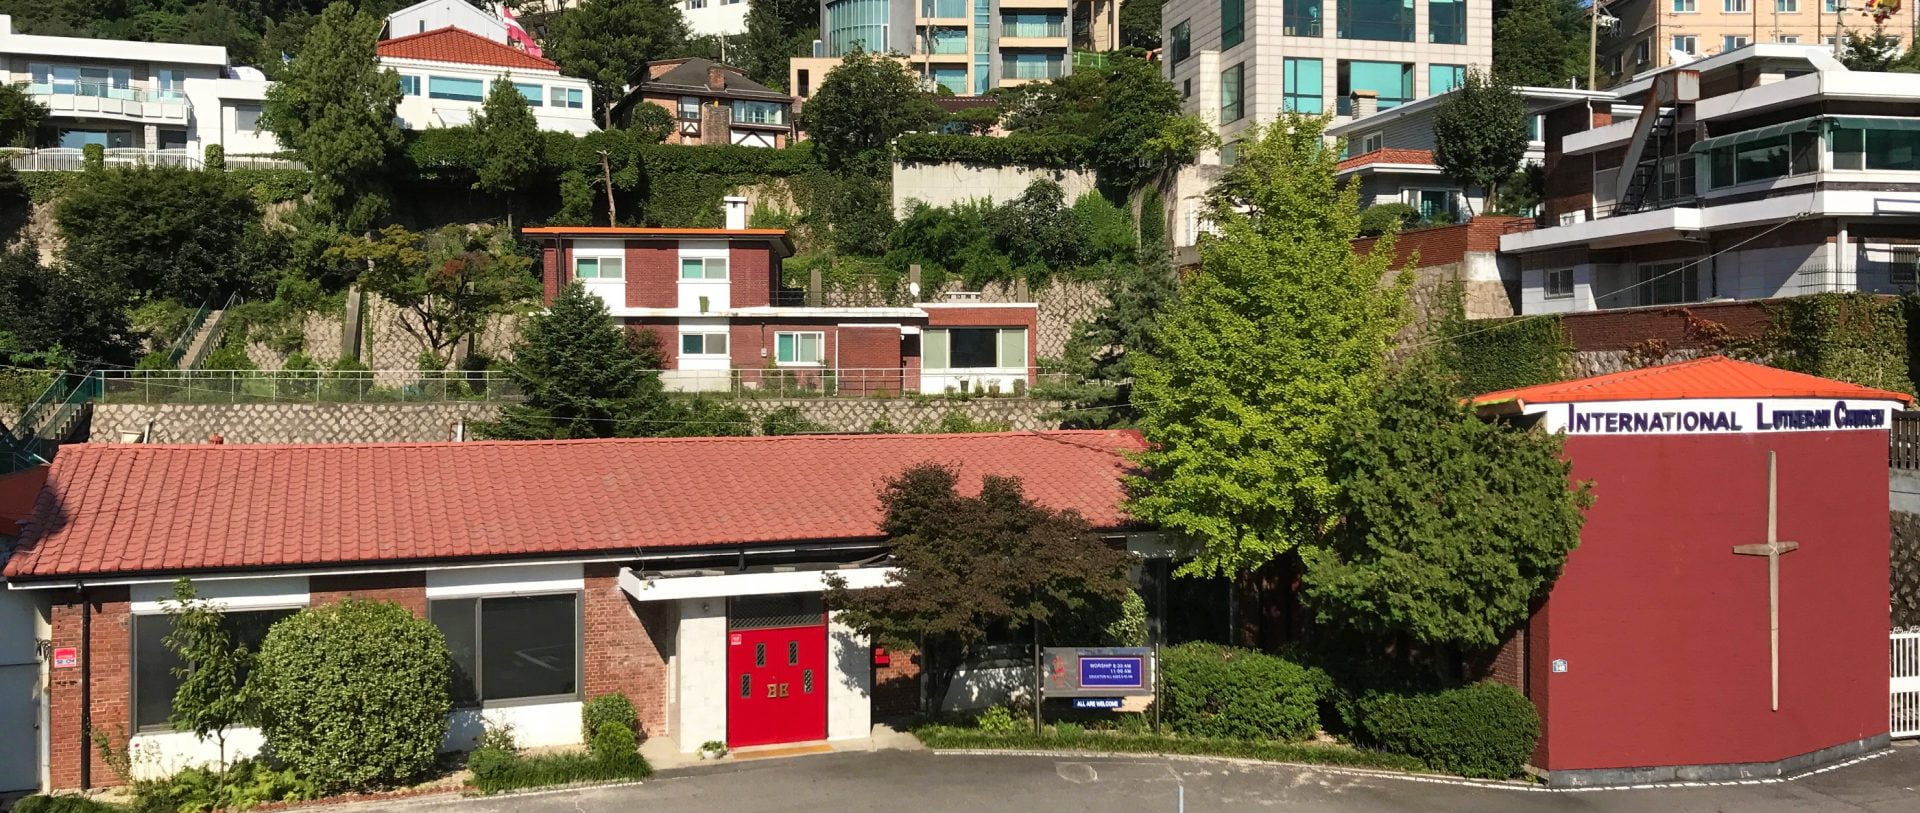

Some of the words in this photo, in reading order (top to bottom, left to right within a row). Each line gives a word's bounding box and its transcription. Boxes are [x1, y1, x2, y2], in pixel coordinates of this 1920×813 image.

[1568, 403, 1742, 432] INTERNATIONAL
[1757, 402, 1831, 430] LUTHERAN
[1834, 400, 1885, 429] CHURCH
